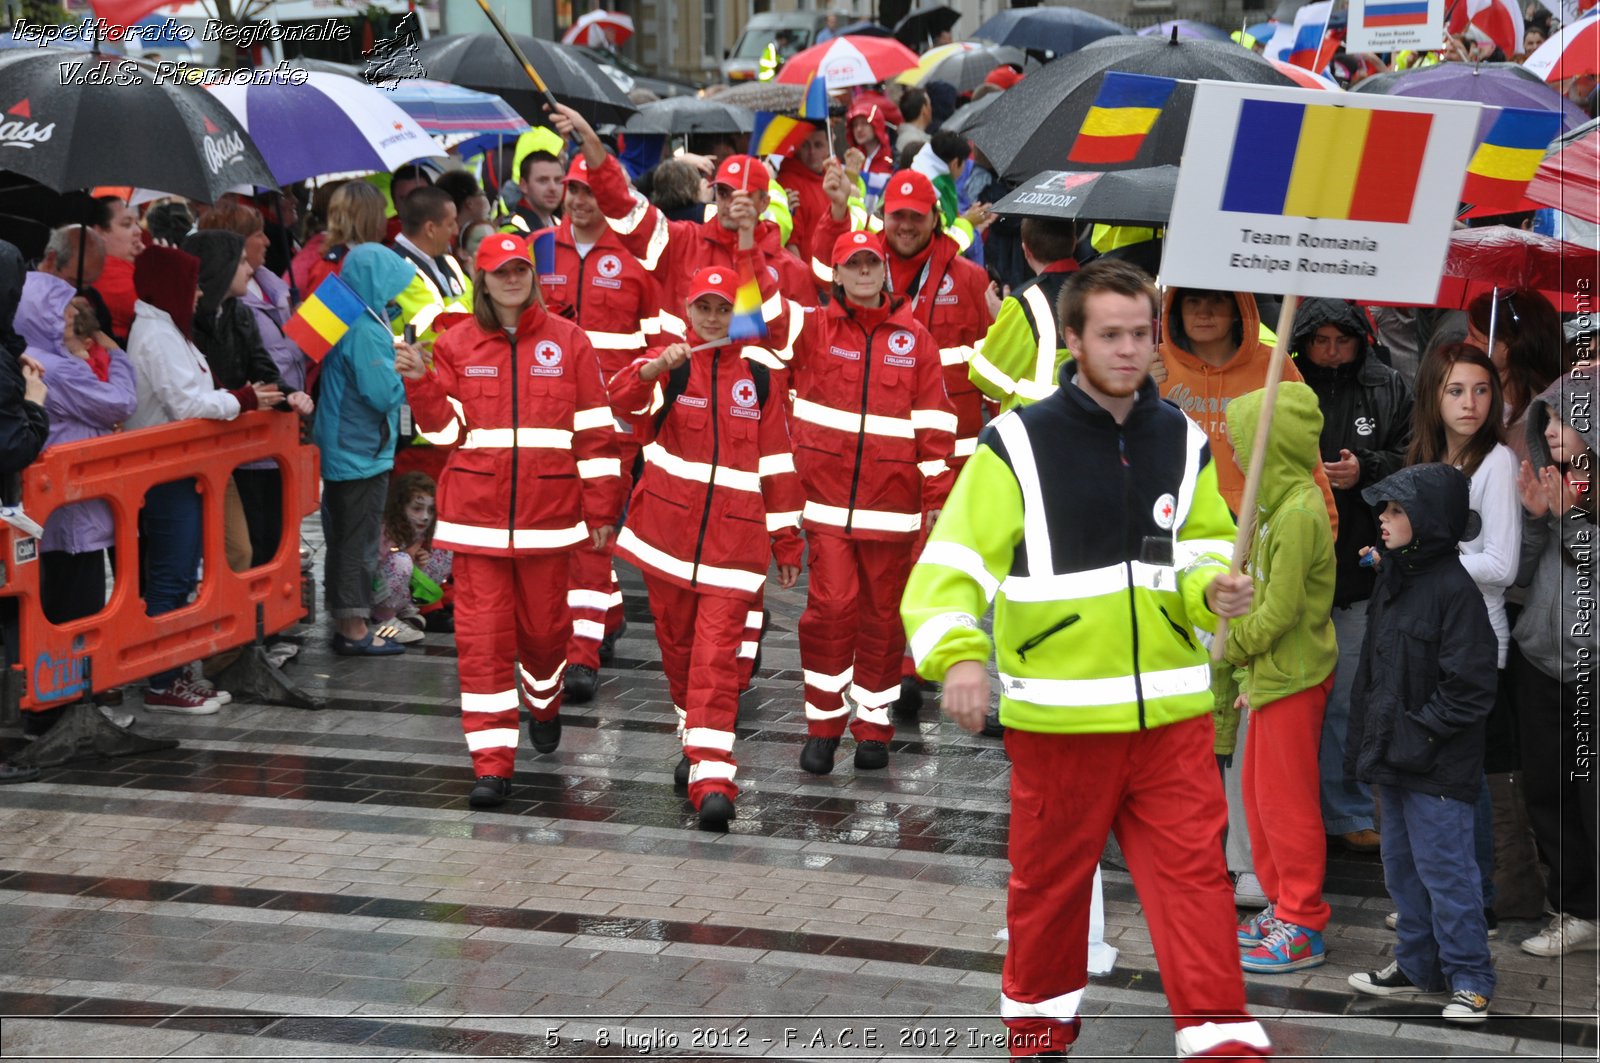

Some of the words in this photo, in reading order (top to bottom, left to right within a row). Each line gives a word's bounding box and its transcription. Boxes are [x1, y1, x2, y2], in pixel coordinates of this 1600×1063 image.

[203, 131, 245, 174] Bass
[1013, 192, 1077, 207] LONDON
[1240, 228, 1290, 246] Team
[1297, 232, 1378, 252] Romania
[1230, 253, 1290, 273] Echipa
[1297, 257, 1378, 276] România
[887, 356, 912, 365] VOLUNTAR
[733, 407, 758, 417] VOLUNTAR
